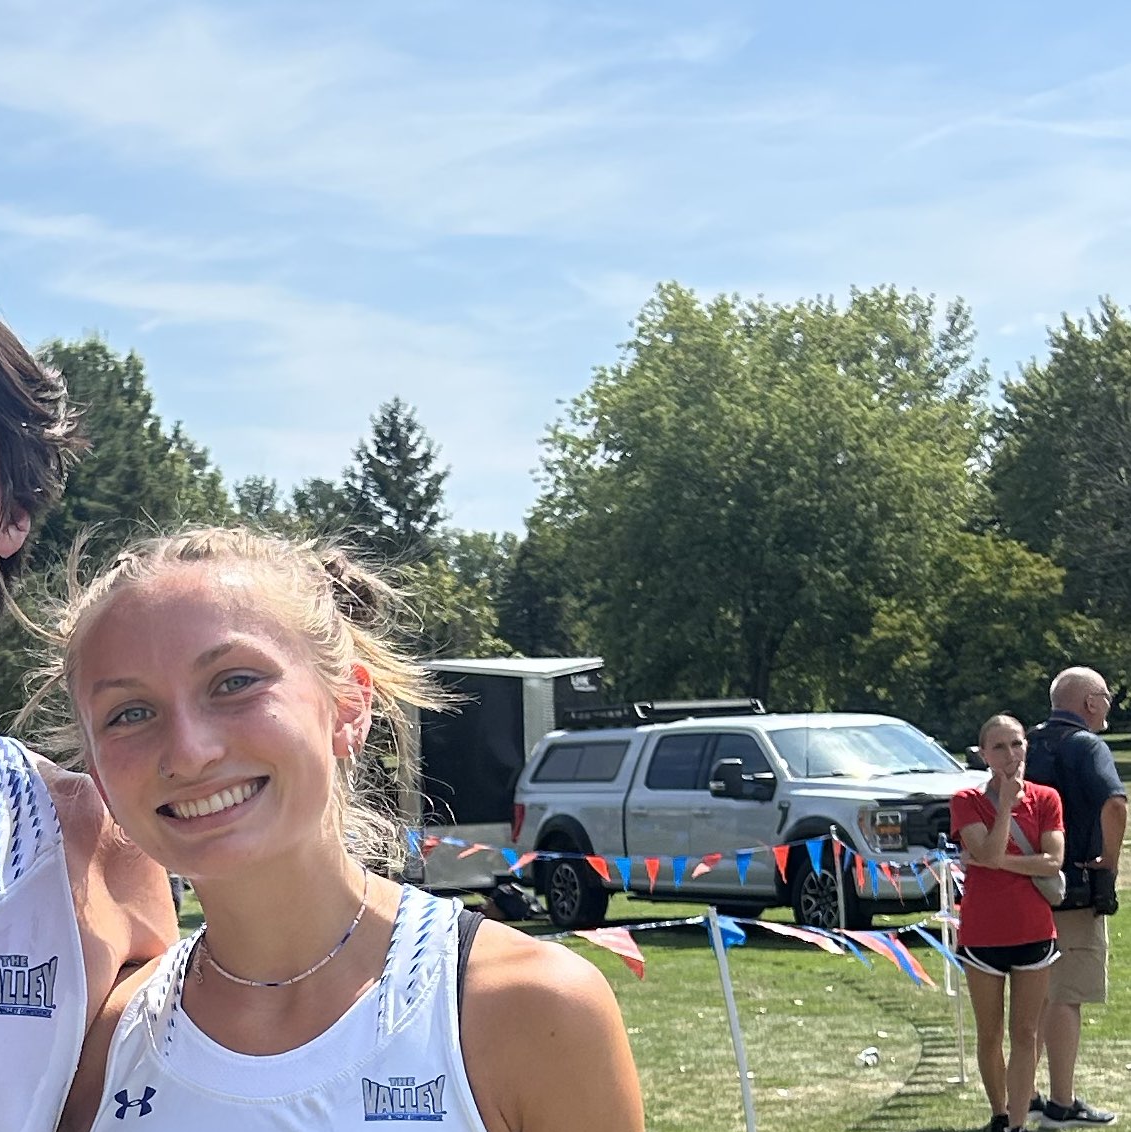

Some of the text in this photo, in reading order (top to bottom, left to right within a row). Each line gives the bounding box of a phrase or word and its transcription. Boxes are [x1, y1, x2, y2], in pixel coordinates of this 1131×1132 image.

[0, 955, 28, 967] THE
[388, 1077, 415, 1086] THE
[362, 1074, 447, 1115] VALLEY
